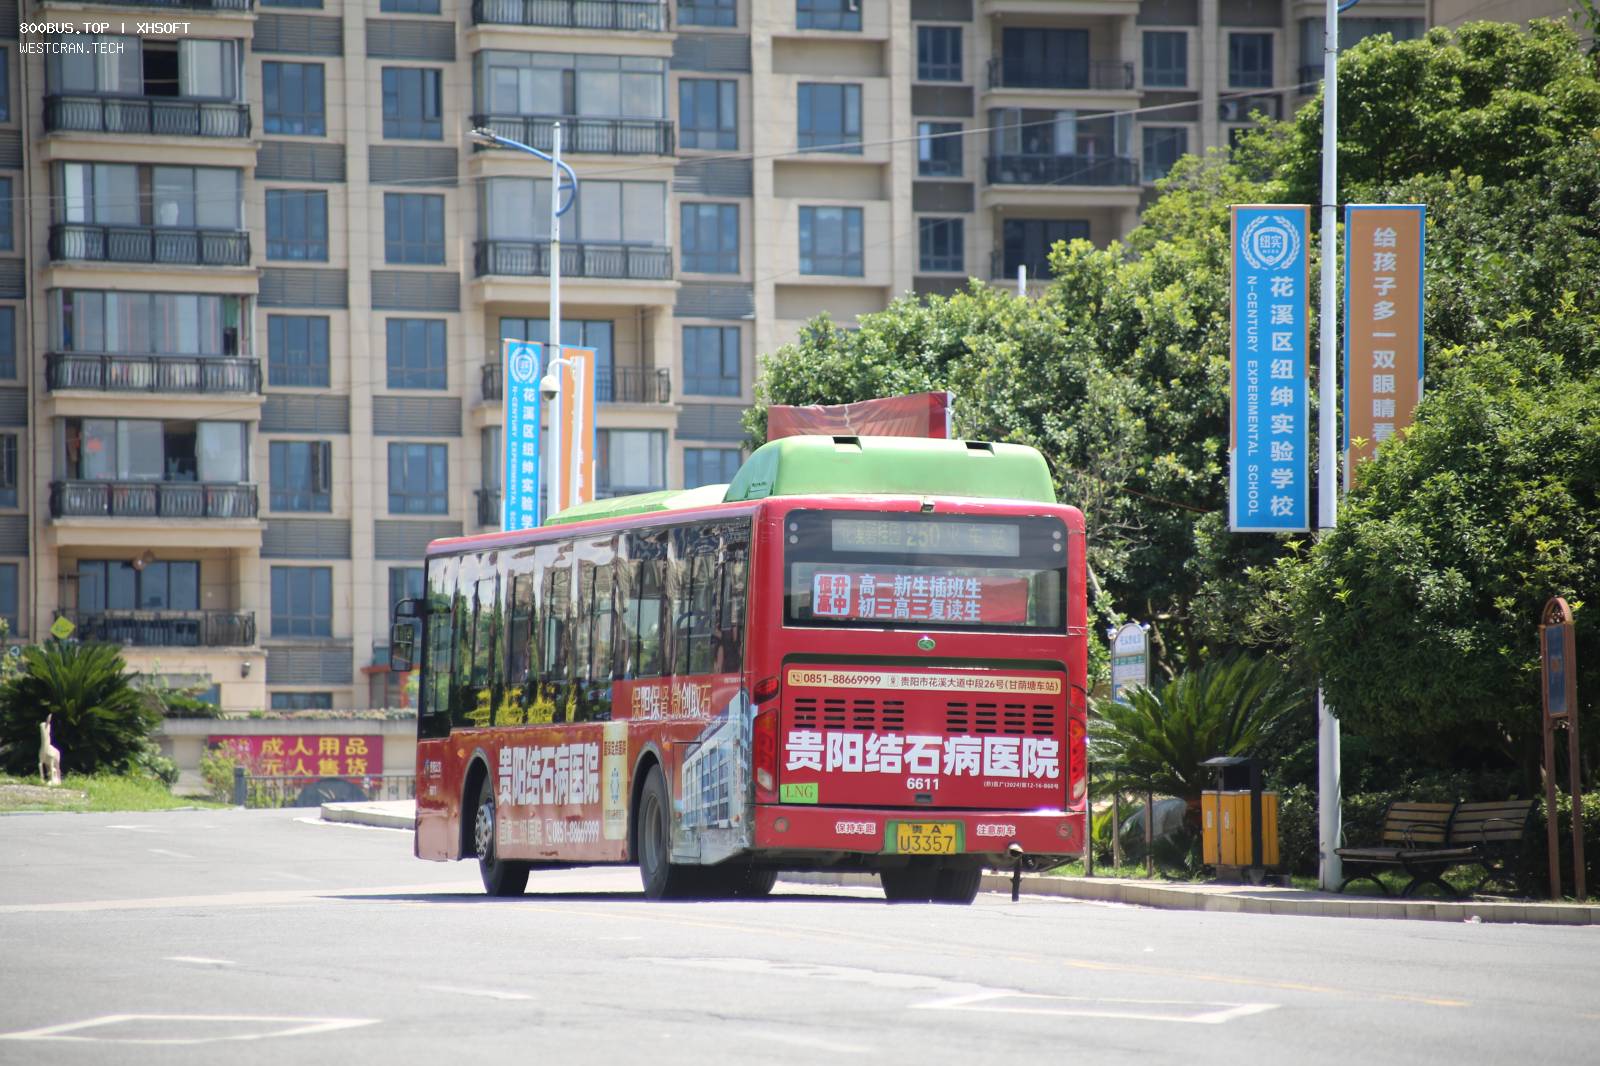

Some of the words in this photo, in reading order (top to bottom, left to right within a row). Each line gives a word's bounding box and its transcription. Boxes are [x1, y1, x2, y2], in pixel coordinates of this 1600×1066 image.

[1260, 235, 1282, 249] 纽实
[1247, 275, 1258, 352] N-CENTURY
[1372, 227, 1398, 460] 给孩子多一双眼睛看
[1247, 360, 1258, 456] EXPERIMENTAL
[1270, 276, 1295, 517] 花溪区纽绅实验学校
[1247, 464, 1259, 516] SCHOOL
[906, 523, 941, 547] 250
[859, 573, 982, 599] 高一新生插班生
[858, 597, 982, 621] 初三高三复读生
[803, 673, 882, 685] 0851-88669999
[632, 685, 669, 720] 保胆保肾
[671, 681, 712, 720] 微创取石
[262, 737, 369, 756] 成人用品
[785, 730, 1060, 779] 贵阳结石病医院
[498, 742, 599, 806] 贵阳结石病医院
[906, 777, 940, 791] 6611
[785, 784, 814, 799] LNG
[836, 822, 876, 834] 保持车距
[977, 824, 1016, 836] 注意刹车
[900, 835, 953, 852] U3357
